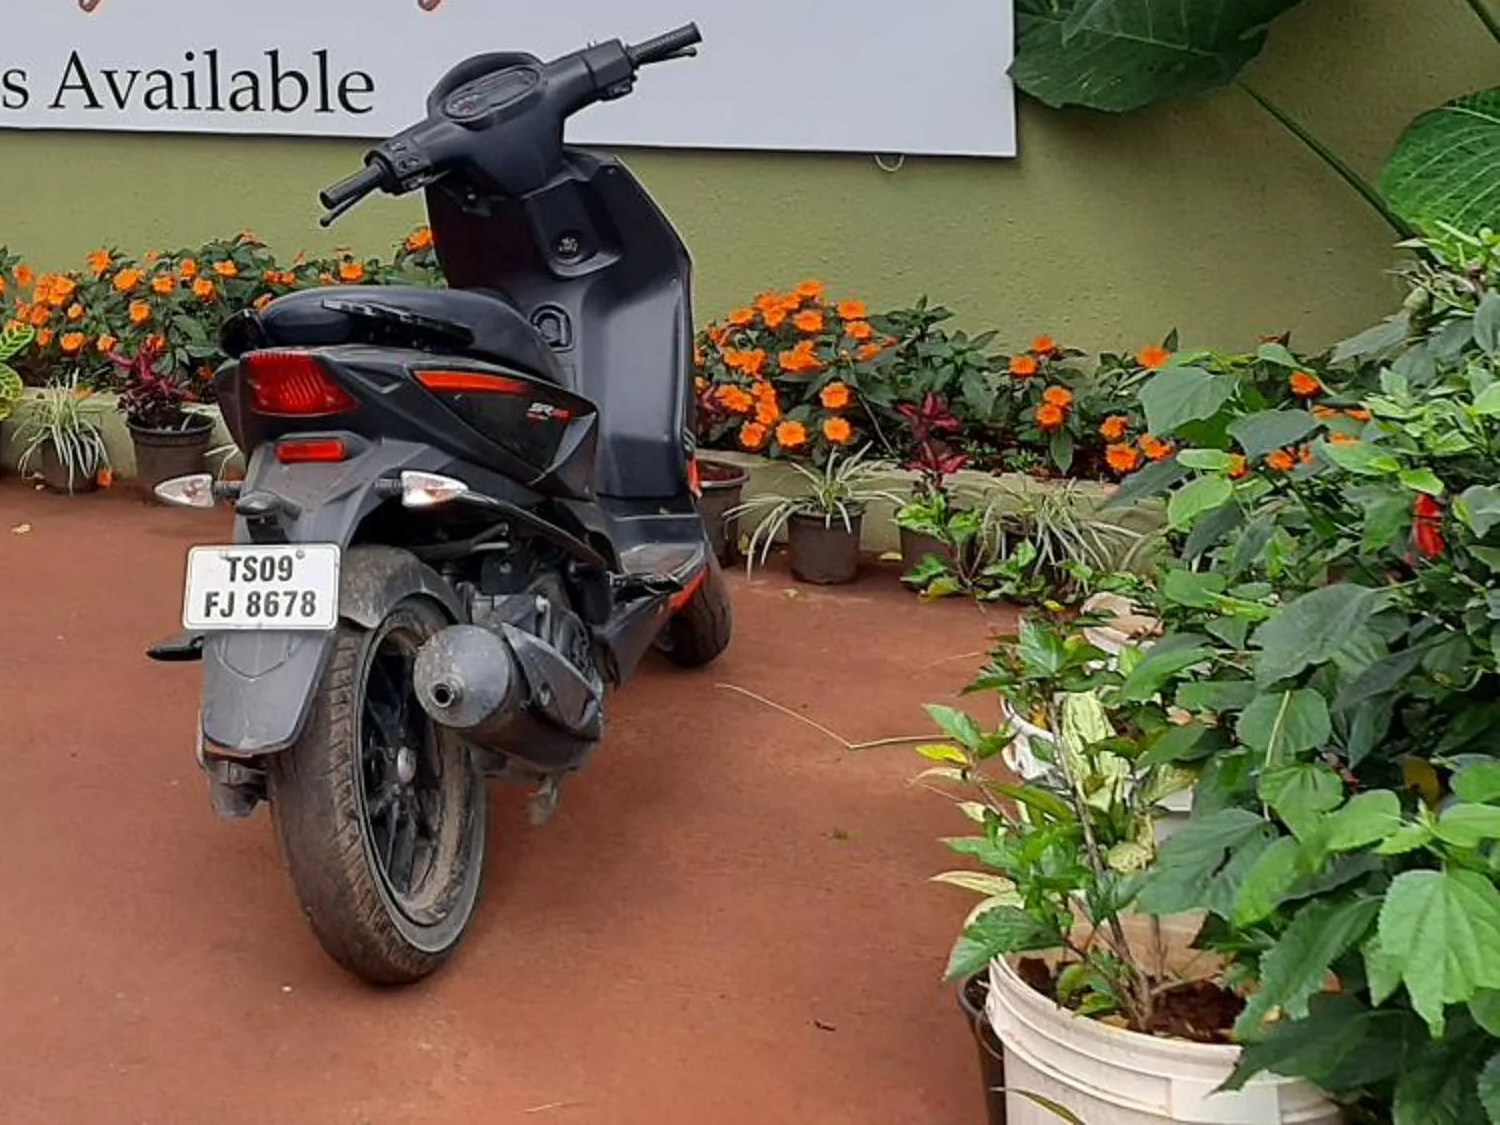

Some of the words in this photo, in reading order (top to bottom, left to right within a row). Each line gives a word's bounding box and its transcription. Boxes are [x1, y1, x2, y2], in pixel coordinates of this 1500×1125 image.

[48, 48, 375, 114] Available
[227, 555, 294, 582] TS09
[203, 591, 236, 618] FJ
[245, 590, 317, 618] 8678
